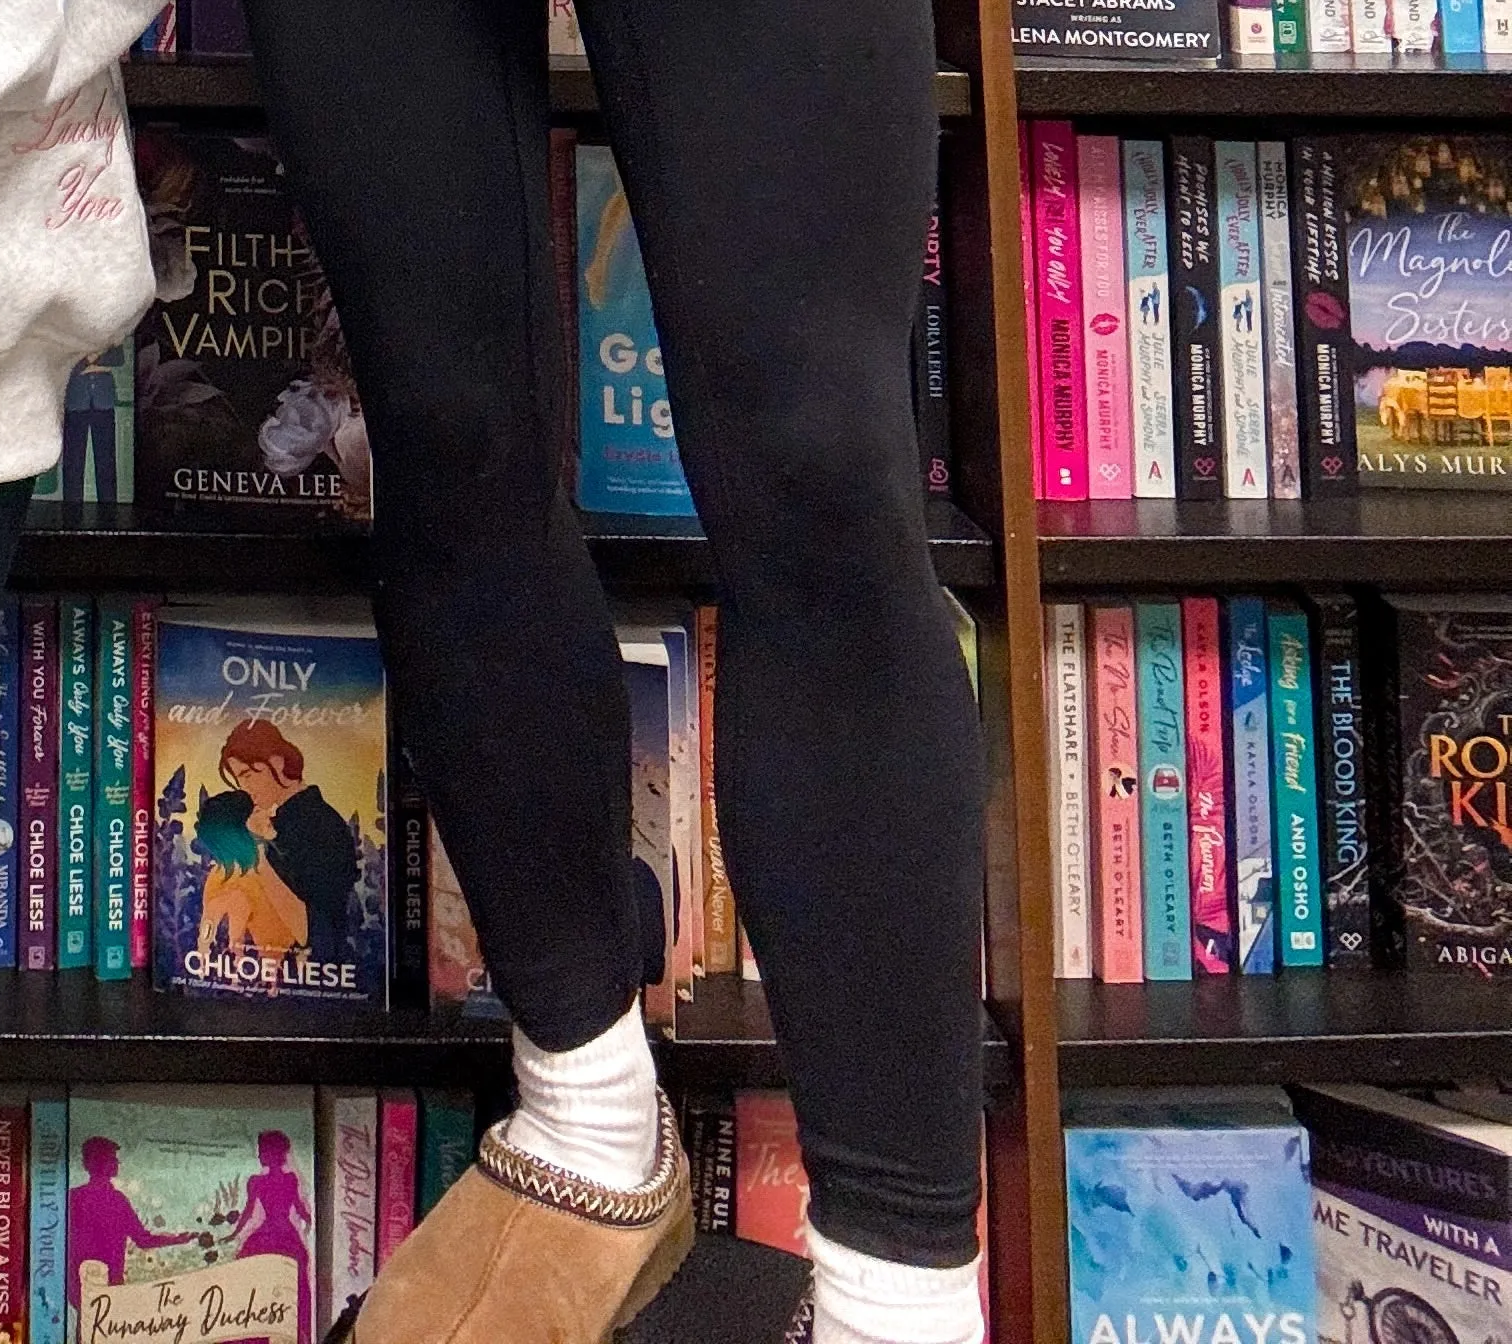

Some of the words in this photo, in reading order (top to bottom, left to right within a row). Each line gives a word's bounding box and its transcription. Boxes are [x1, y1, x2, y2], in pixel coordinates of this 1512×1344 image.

[1064, 30, 1210, 50] MONTGOMERY
[12, 87, 126, 165] Lucky
[44, 162, 125, 231] You
[173, 468, 286, 496] GENEVA
[297, 473, 342, 498] LEE
[1356, 452, 1428, 474] ALYS
[222, 655, 317, 693] ONLY
[1330, 659, 1352, 709] THE
[1331, 712, 1356, 797] BLOOD
[1336, 800, 1358, 864] KING
[184, 952, 277, 985] CHLOE
[282, 957, 357, 988] LIESE
[1358, 1221, 1503, 1306] TRAVELER
[91, 1295, 192, 1341] Runaway
[199, 1284, 291, 1337] Duchess
[157, 1279, 184, 1312] The
[1089, 1312, 1307, 1344] ALWAYS
